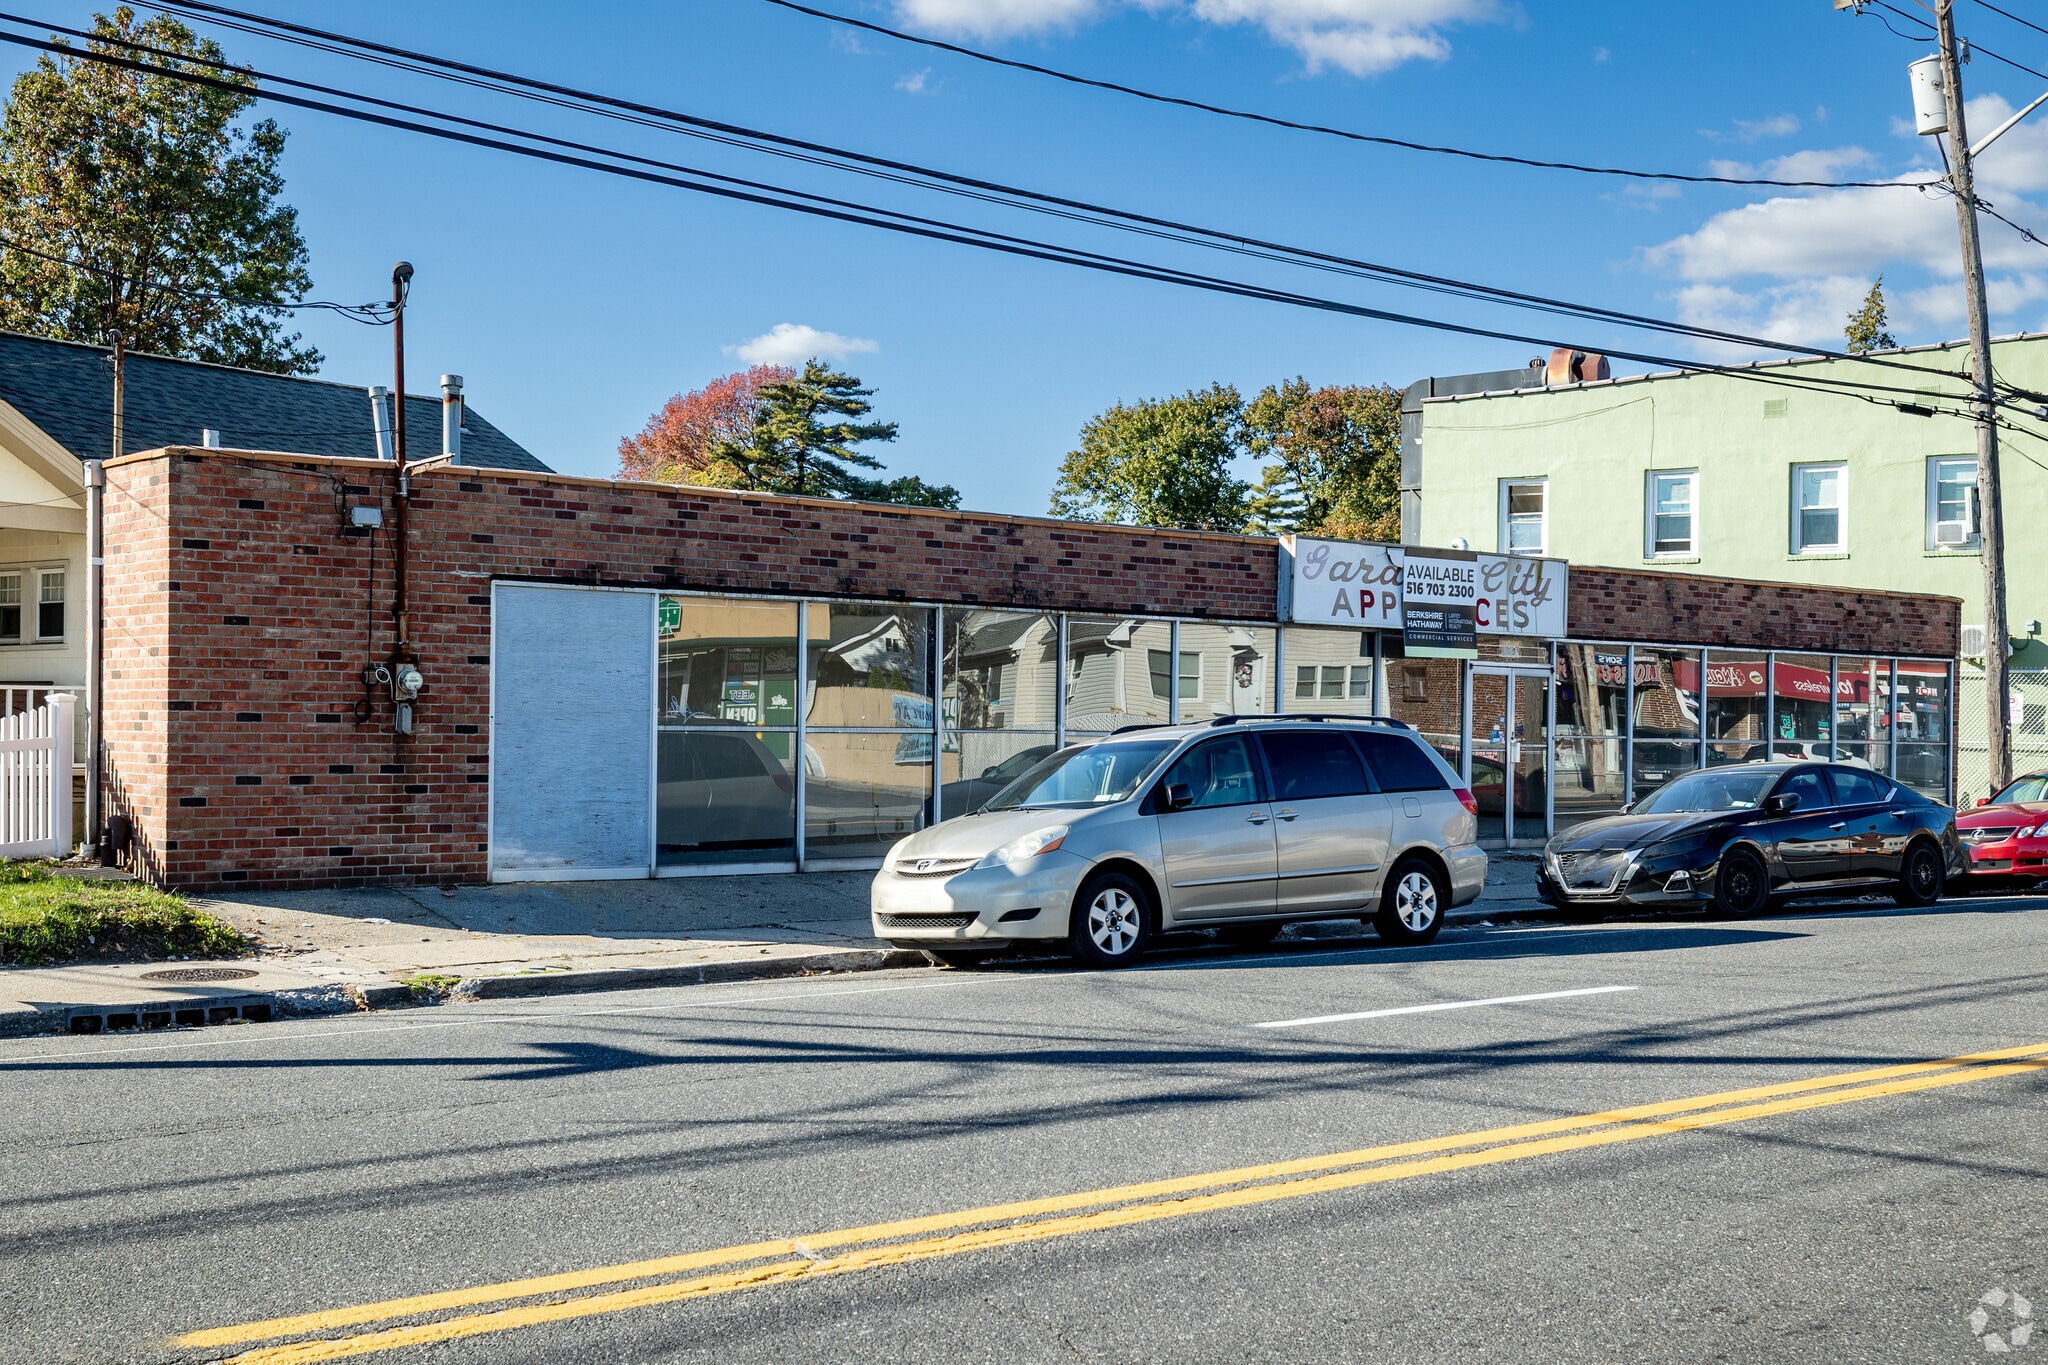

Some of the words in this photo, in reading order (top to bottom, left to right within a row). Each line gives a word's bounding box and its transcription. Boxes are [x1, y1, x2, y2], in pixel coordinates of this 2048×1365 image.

[1406, 564, 1475, 583] AVAILABLE
[1406, 582, 1424, 595] 516
[1426, 583, 1445, 597] 703
[1448, 585, 1475, 598] 2300
[1480, 560, 1553, 608] City
[1406, 610, 1443, 620] BERKSHIRE
[1406, 620, 1443, 629] HATHAWAY
[1408, 633, 1444, 641] COMMERCIAL
